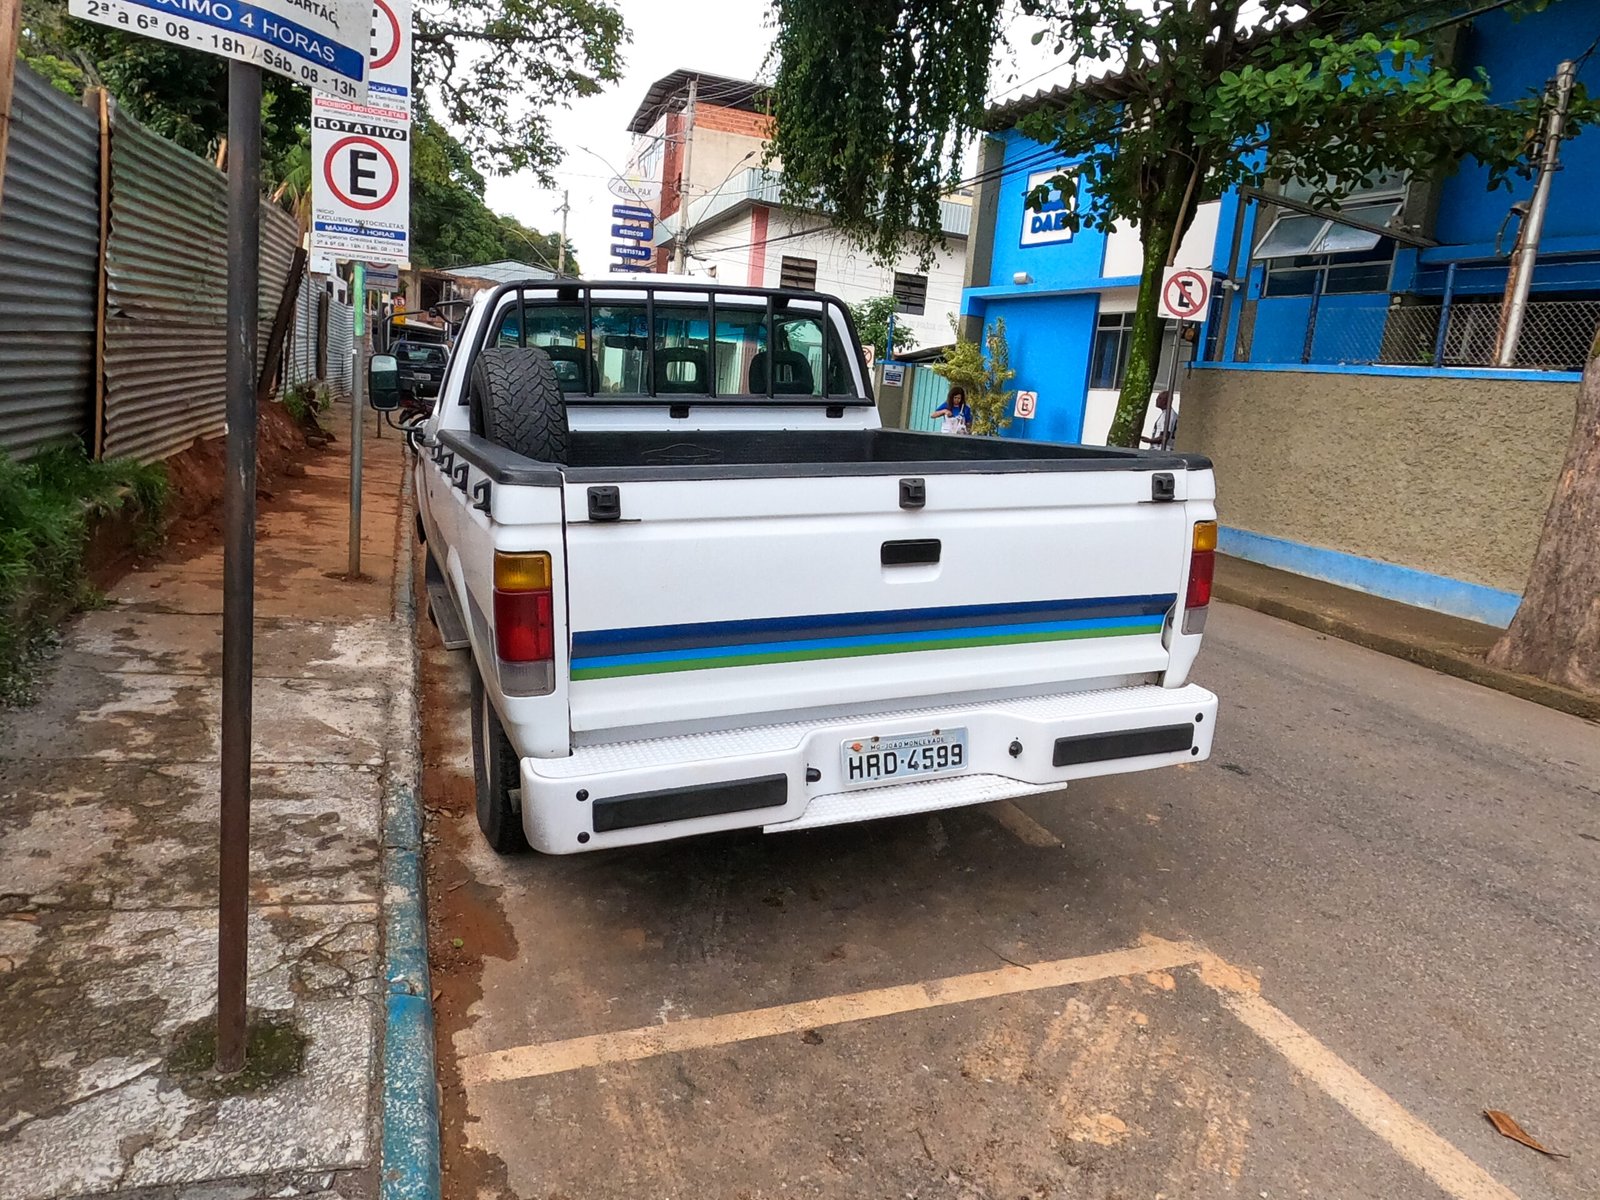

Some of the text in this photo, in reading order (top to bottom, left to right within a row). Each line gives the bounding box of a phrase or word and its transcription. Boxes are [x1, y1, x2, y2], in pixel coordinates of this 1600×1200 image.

[240, 13, 254, 28] 4
[263, 18, 335, 62] HORAS
[87, 1, 109, 16] 2ª
[118, 11, 129, 24] a
[137, 14, 158, 29] 6ª
[165, 22, 190, 41] 08
[211, 34, 245, 55] 18h
[263, 49, 296, 76] Sáb.
[301, 65, 318, 83] 08
[331, 78, 357, 98] 13h
[317, 99, 405, 119] PROIBIDO MOTOCICLETAS
[317, 118, 403, 139] ROTATIVO
[349, 149, 377, 199] E
[618, 185, 652, 196] REAL PAX
[317, 215, 405, 230] EXCLUSIVO MOTOCICLETAS
[1031, 211, 1067, 233] DAE
[367, 229, 395, 239] HORAS
[1178, 281, 1192, 308] E
